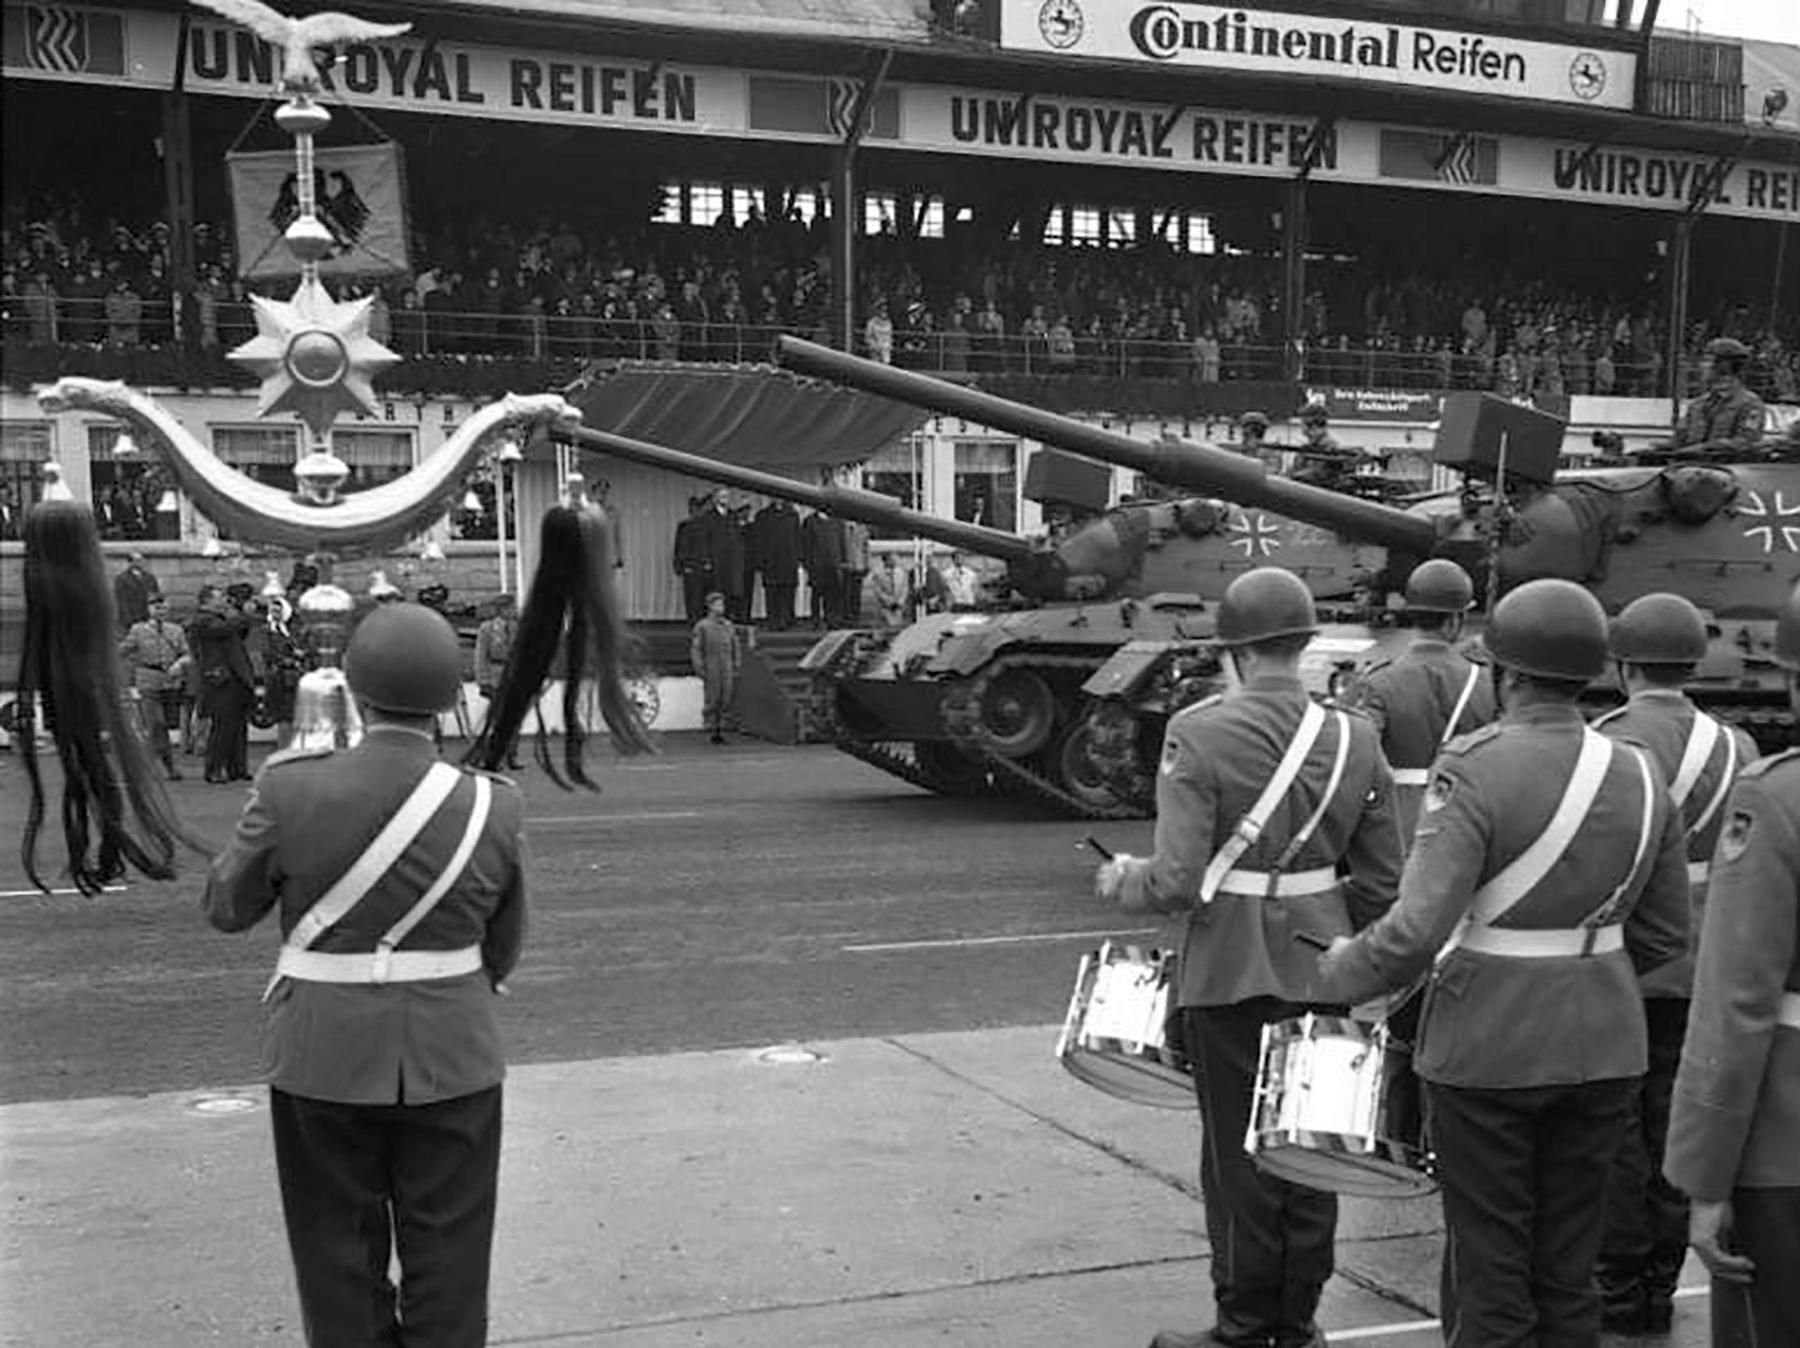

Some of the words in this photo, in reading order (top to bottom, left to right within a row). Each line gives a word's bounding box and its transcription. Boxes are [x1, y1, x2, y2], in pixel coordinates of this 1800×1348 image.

[190, 27, 485, 104] UNROYAL
[510, 57, 697, 122] REIFEN
[1130, 4, 1398, 69] Continental
[1412, 32, 1525, 83] Reifen
[951, 96, 1173, 158] UNIROYAL
[1193, 116, 1337, 170] REIFEN
[1554, 148, 1731, 205] UNIROYAL
